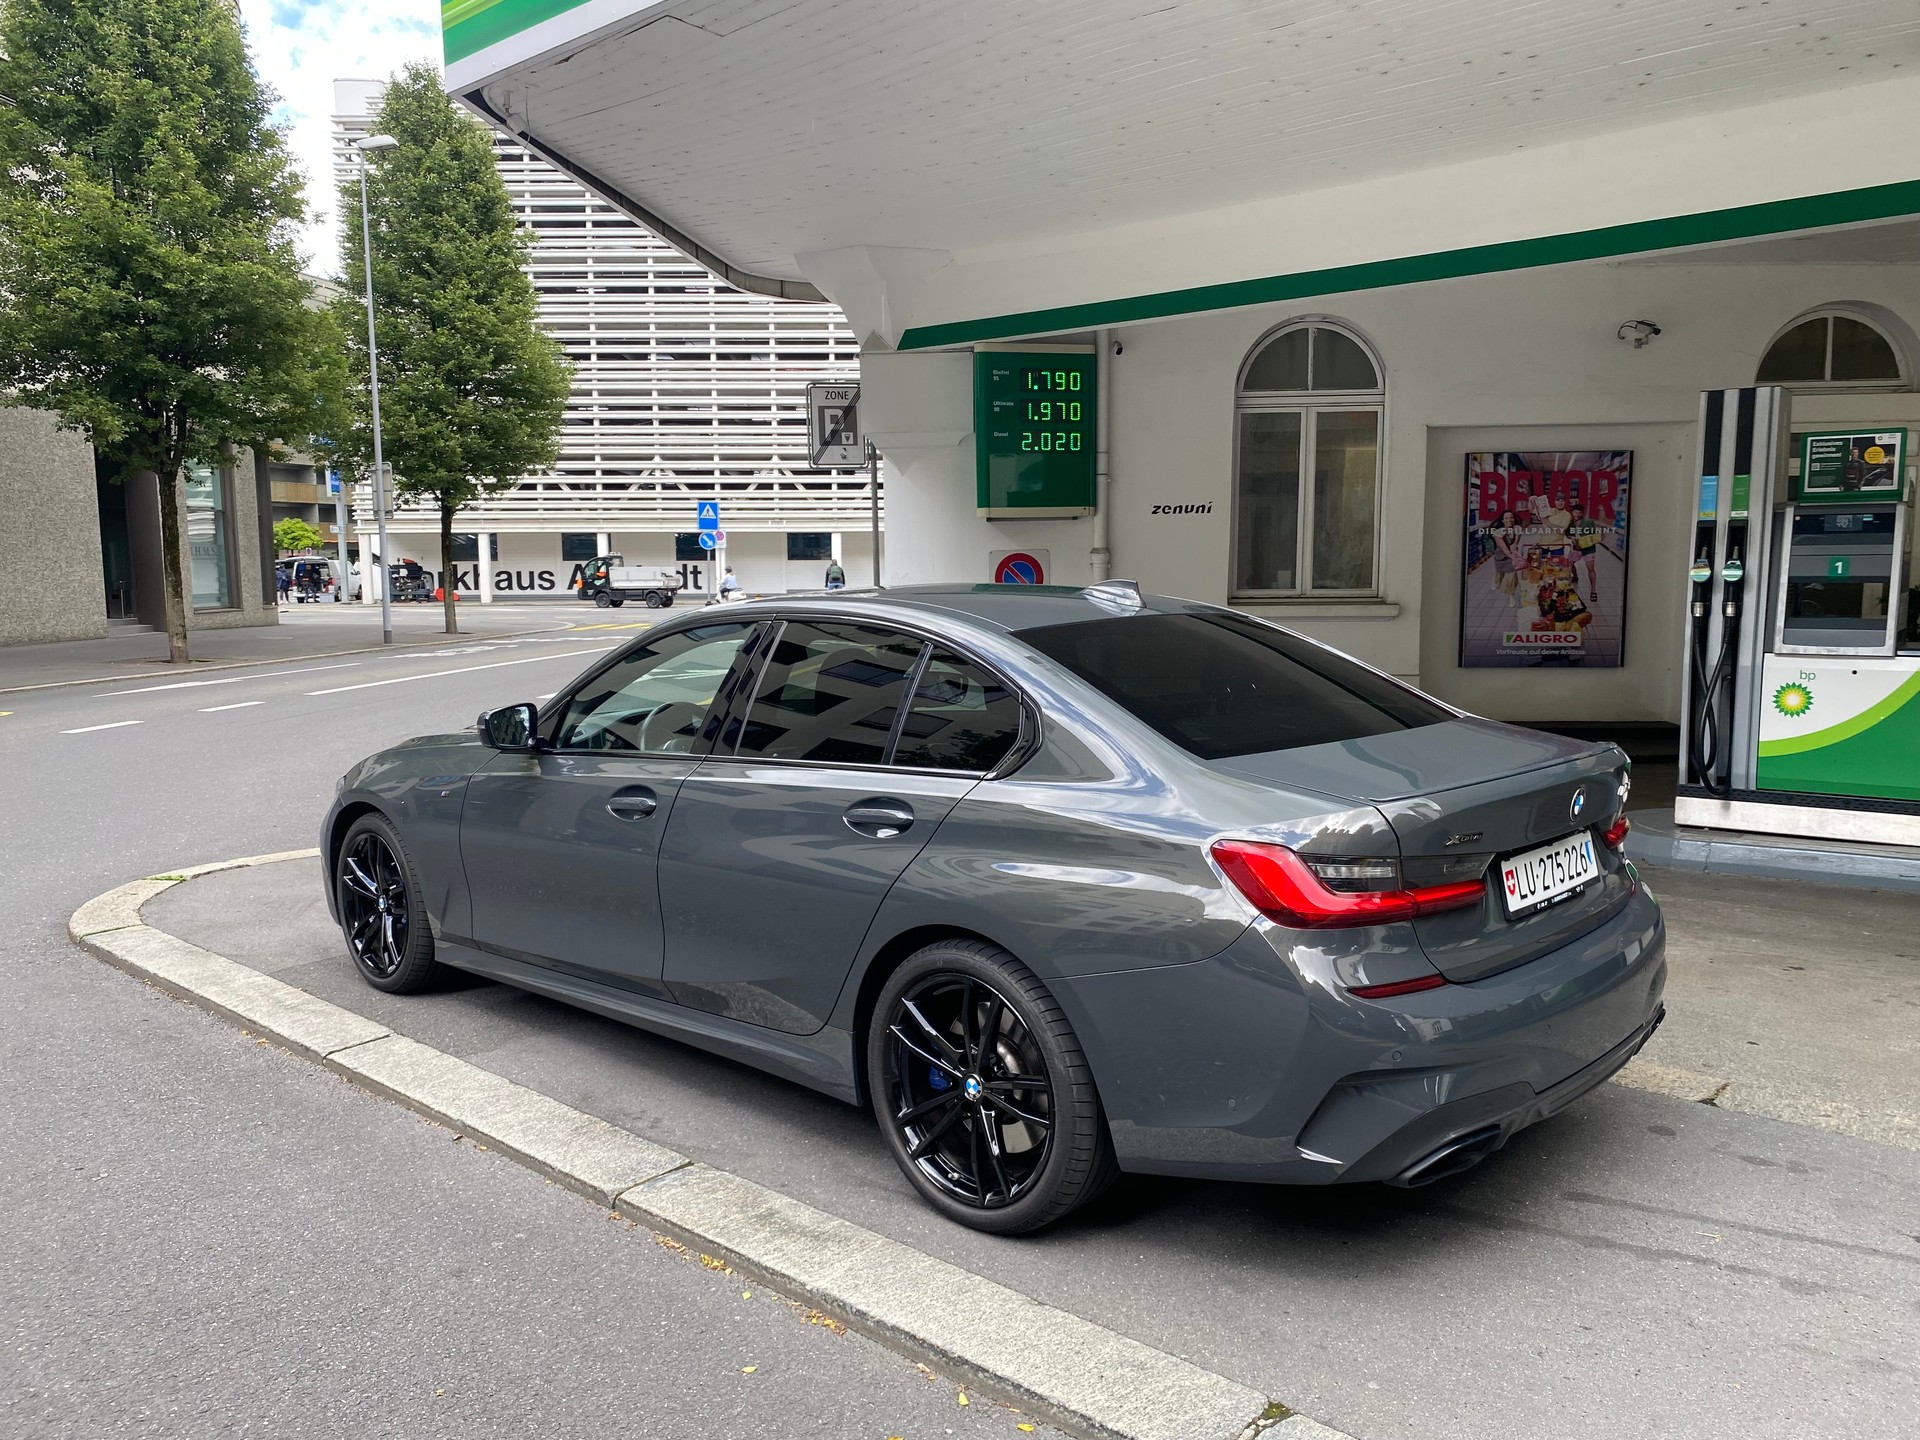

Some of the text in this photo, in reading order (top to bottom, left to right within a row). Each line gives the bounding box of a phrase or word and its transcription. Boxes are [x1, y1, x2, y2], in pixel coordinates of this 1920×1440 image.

[1028, 371, 1081, 391] 1.790
[824, 390, 849, 400] ZONE
[1028, 402, 1081, 421] 1.970
[1021, 432, 1081, 451] 2.020
[1478, 470, 1618, 521] BEVOR
[1151, 501, 1213, 515] zenuni
[1501, 527, 1565, 535] GRILLPARTY
[1570, 526, 1617, 535] BEGINNT
[1834, 561, 1844, 574] 1
[1512, 634, 1578, 644] ALIGRO
[1799, 670, 1817, 682] bp
